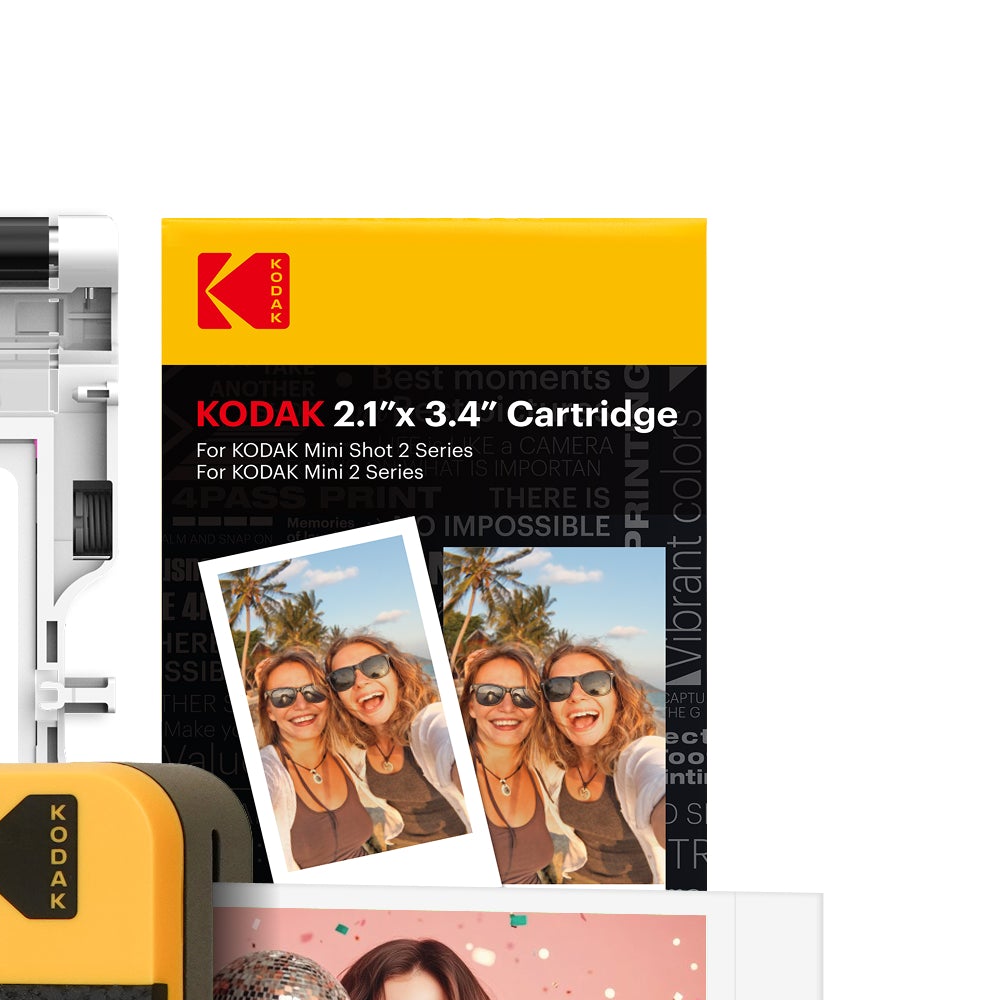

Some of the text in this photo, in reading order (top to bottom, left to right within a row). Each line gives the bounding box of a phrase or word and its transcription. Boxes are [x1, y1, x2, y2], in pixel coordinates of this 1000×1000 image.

[270, 258, 283, 323] KODAK
[209, 380, 316, 398] ANOTHER
[373, 366, 612, 391] Best moments
[197, 400, 325, 427] KODAK
[507, 400, 679, 433] Cartridge
[196, 442, 226, 459] For
[232, 442, 299, 459] KODAK
[304, 442, 342, 459] Mini
[349, 442, 393, 459] Shot
[398, 442, 410, 458] 2
[416, 442, 474, 459] Series
[501, 441, 512, 455] a
[520, 436, 614, 455] CAMERA
[196, 464, 424, 480] For KODAK Mini 2 Series
[471, 460, 488, 478] IS
[496, 461, 601, 477] IMPORTAN
[659, 409, 702, 524] colors
[171, 486, 443, 509] 4PASS PRINT
[489, 487, 611, 509] THERE IS
[287, 516, 355, 529] Memories
[444, 515, 611, 537] IMPOSSIBLE
[190, 533, 216, 545] AND
[220, 533, 250, 545] SNAP
[254, 533, 273, 545] ON
[665, 536, 703, 669] Vibrant
[666, 706, 686, 719] HE
[164, 719, 216, 738] Make
[163, 741, 247, 776] Valu
[49, 804, 69, 910] KODAK
